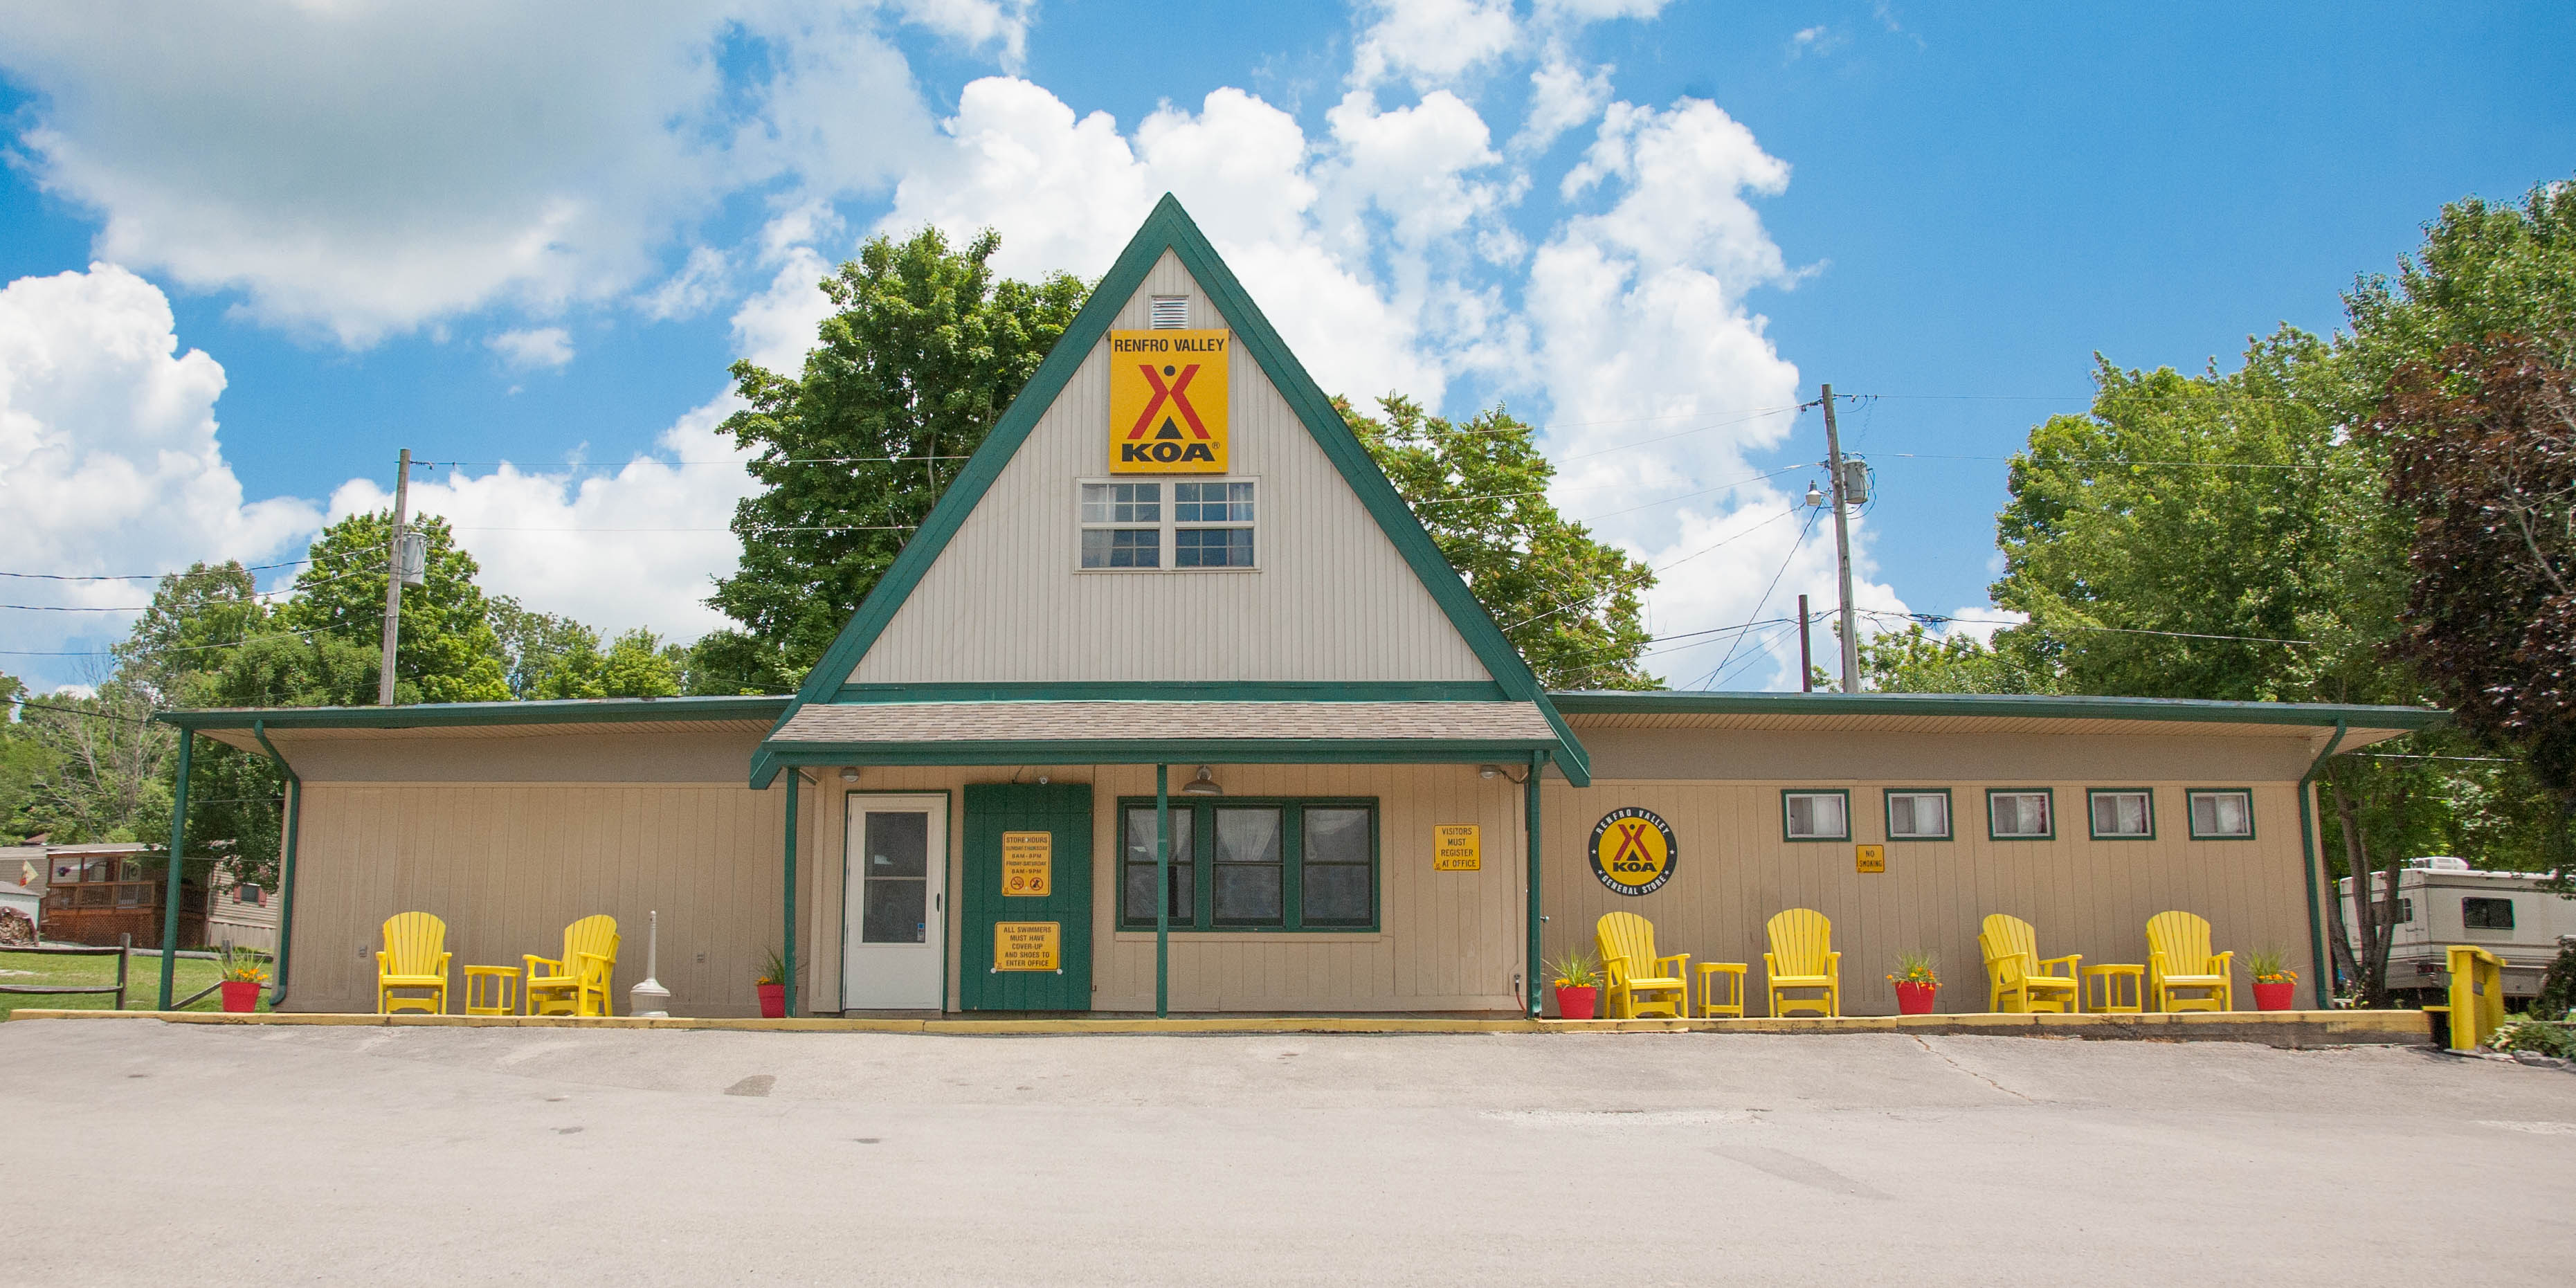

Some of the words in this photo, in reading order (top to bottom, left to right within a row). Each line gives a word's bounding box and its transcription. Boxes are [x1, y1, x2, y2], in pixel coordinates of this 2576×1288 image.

[1114, 338, 1169, 352] RENFRO
[1174, 338, 1225, 352] VALLEY
[1121, 442, 1215, 463] KOA
[1595, 808, 1631, 835] RENFRO
[1638, 810, 1669, 835] VALLEY
[1441, 849, 1473, 857] REGISTER
[1452, 859, 1476, 867] OFFICE
[1613, 862, 1658, 872] KOA
[1602, 875, 1638, 895] GENERAL
[1642, 875, 1667, 894] STORE
